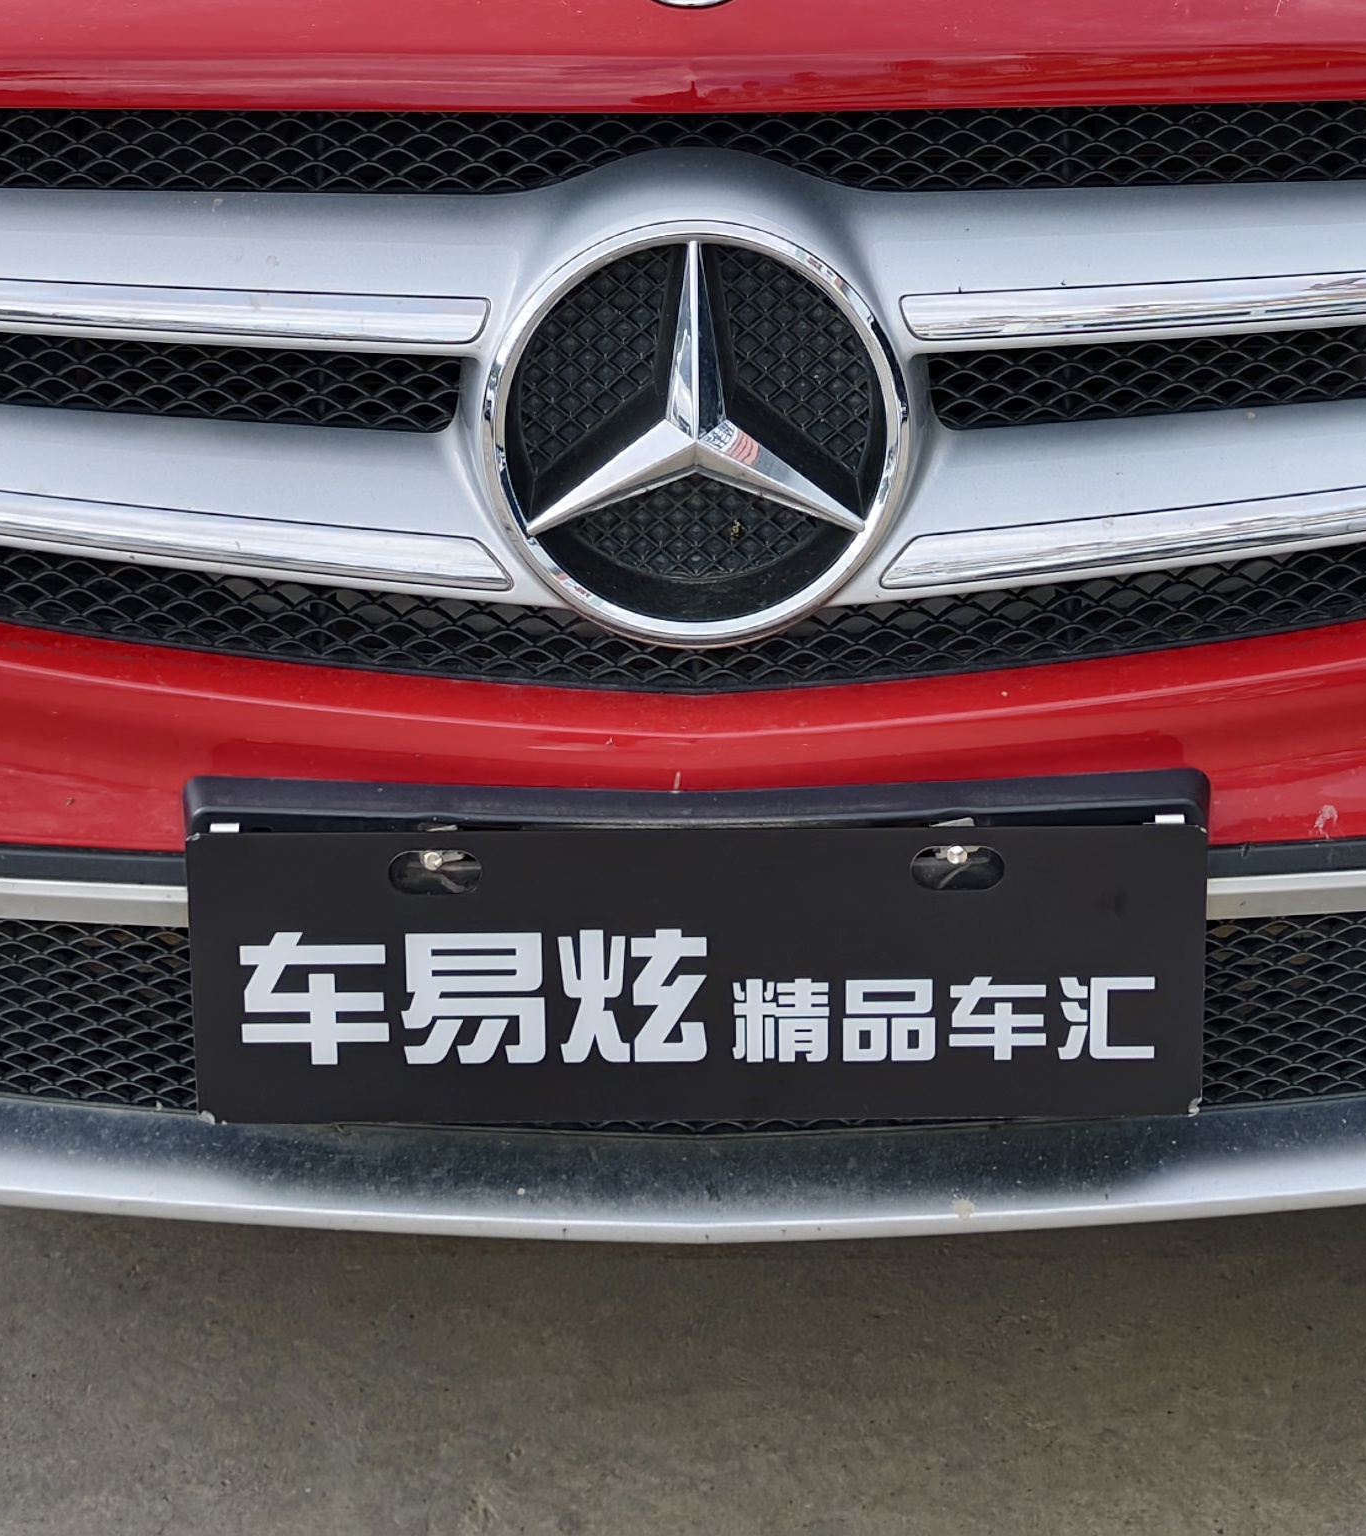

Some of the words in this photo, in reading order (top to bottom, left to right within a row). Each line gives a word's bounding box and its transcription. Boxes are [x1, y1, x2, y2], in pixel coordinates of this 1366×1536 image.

[239, 928, 708, 1065] 车易炫
[732, 975, 1156, 1062] 精品车汇
